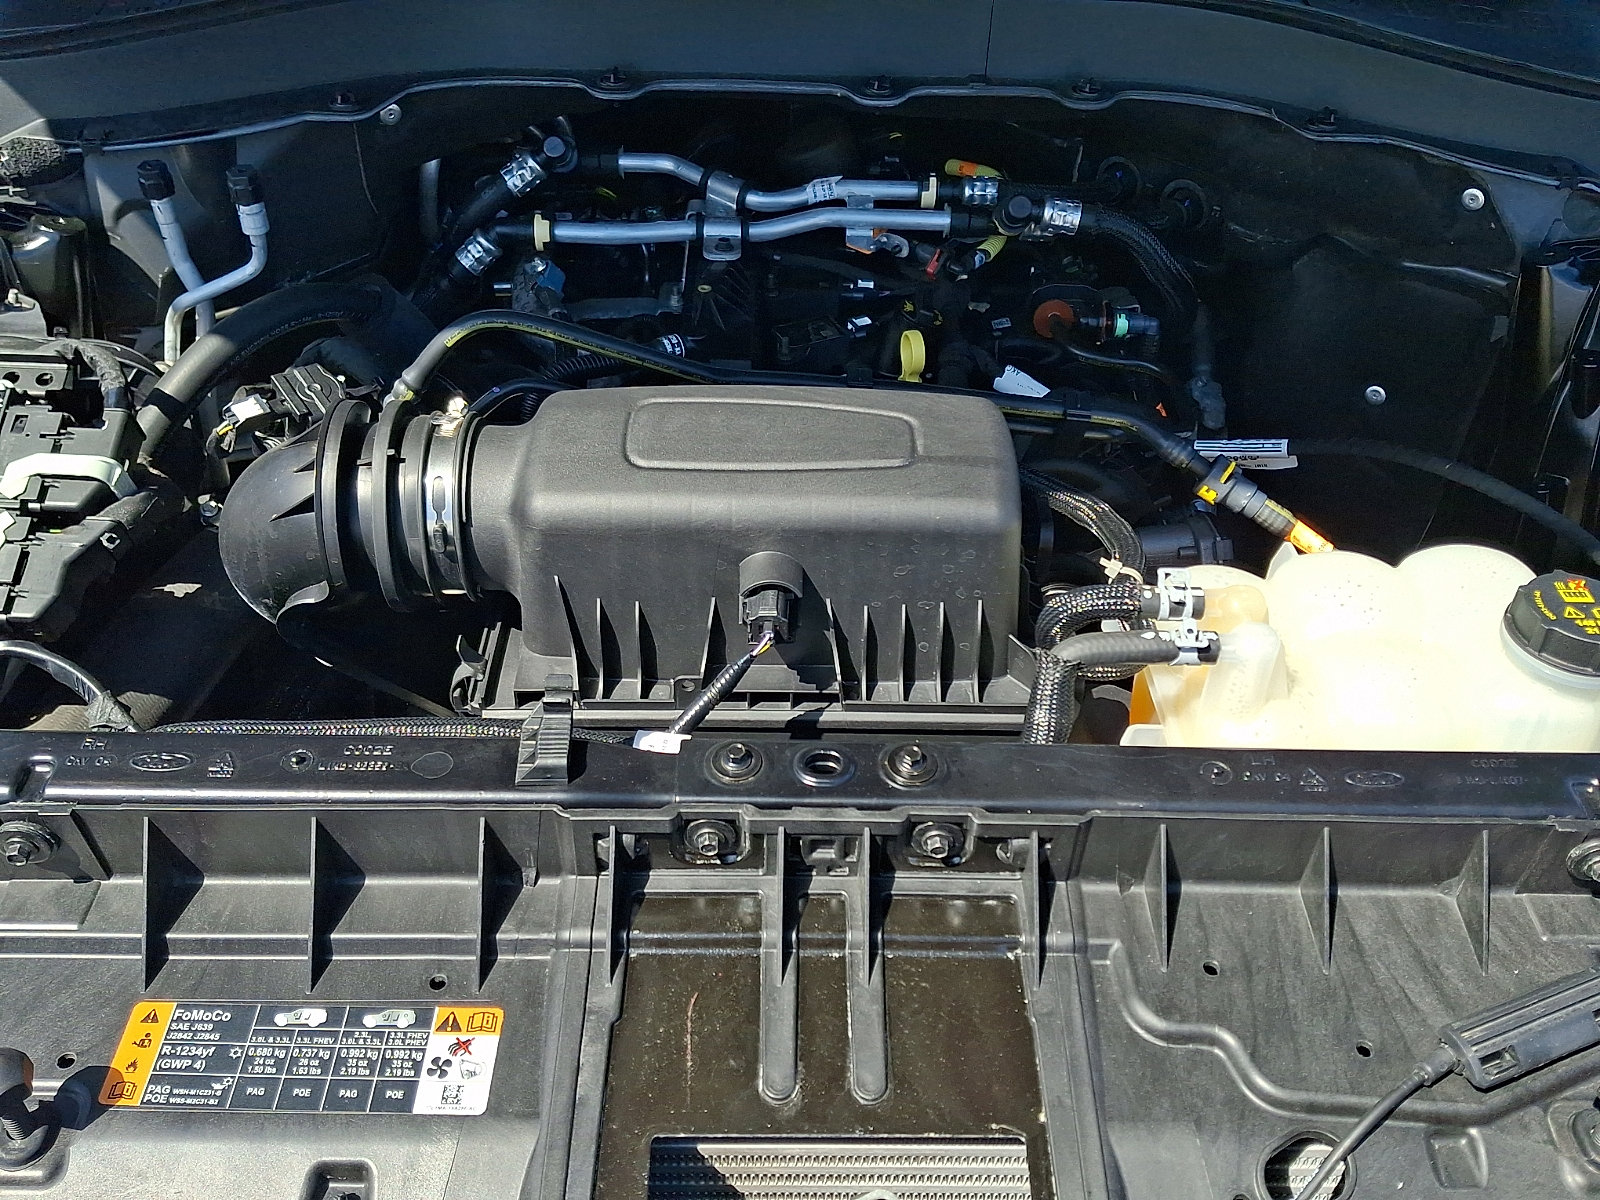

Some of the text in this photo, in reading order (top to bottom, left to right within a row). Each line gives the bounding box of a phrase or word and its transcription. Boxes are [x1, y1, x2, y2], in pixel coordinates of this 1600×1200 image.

[172, 1009, 231, 1022] FoMoCo
[170, 1022, 214, 1031] SAE J639
[313, 1037, 335, 1045] FHEV
[161, 1045, 216, 1058] R-1234yf
[248, 1047, 287, 1059] 0.680 kg
[292, 1048, 331, 1060] 0.737 kg
[340, 1048, 379, 1060] 0.992 kg
[385, 1049, 424, 1061] 0.992 kg
[156, 1059, 206, 1072] (GWP 4)
[391, 1060, 402, 1068] 35
[247, 1065, 277, 1074] 1.50 lbs
[292, 1067, 321, 1075] 1.63 lbs
[340, 1067, 370, 1076] 2.19 lbs
[385, 1068, 415, 1077] 2.19 lbs
[146, 1085, 171, 1094] PAG
[246, 1087, 265, 1096] PAG
[292, 1088, 312, 1097] POE
[339, 1089, 358, 1098] PAG
[143, 1094, 169, 1103] POE
[385, 1090, 405, 1099] POE
